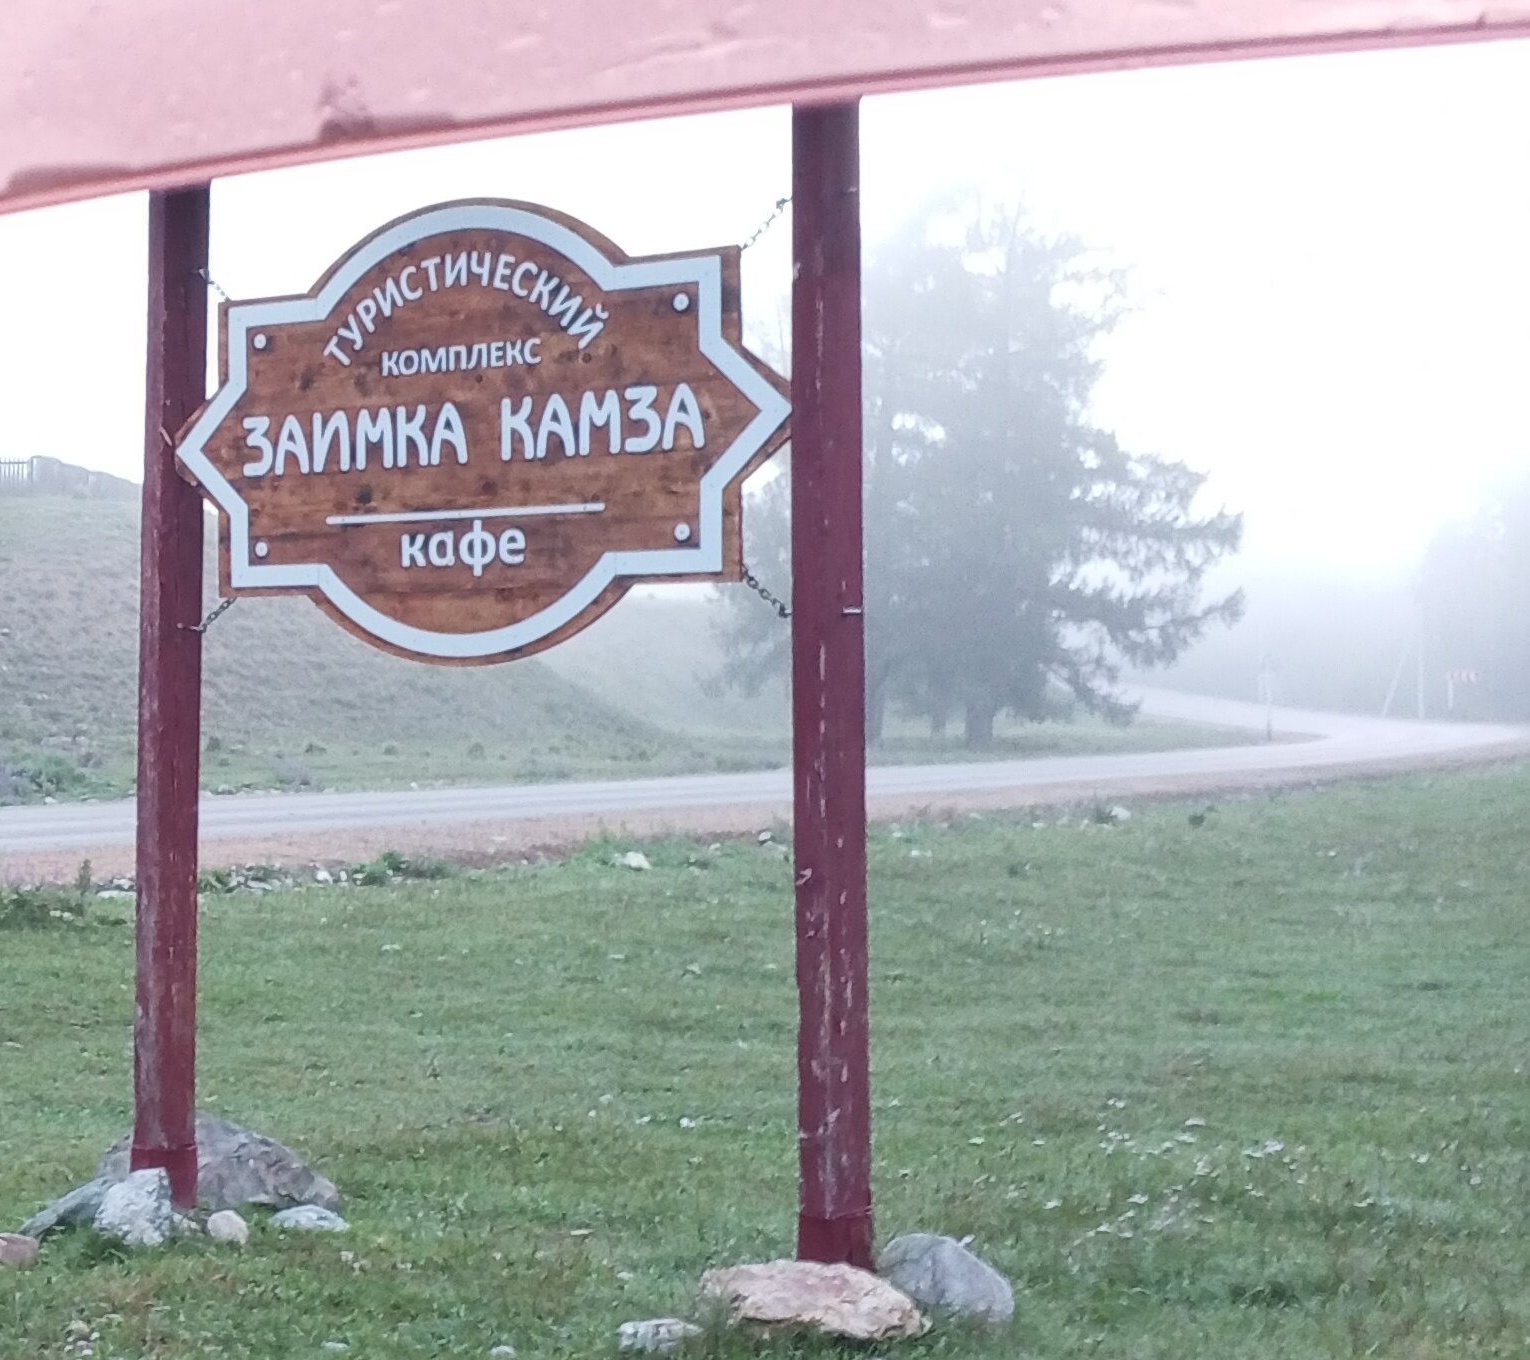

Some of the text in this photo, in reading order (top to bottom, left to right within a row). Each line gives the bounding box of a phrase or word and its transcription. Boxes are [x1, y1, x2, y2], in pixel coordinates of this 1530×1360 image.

[324, 251, 609, 366] ТУРИСТИЧЕСКИЙ
[381, 338, 542, 377] КОМПЛЕКС
[243, 383, 706, 477] ЗАИМКА КАМЗА
[401, 520, 527, 577] кафе
